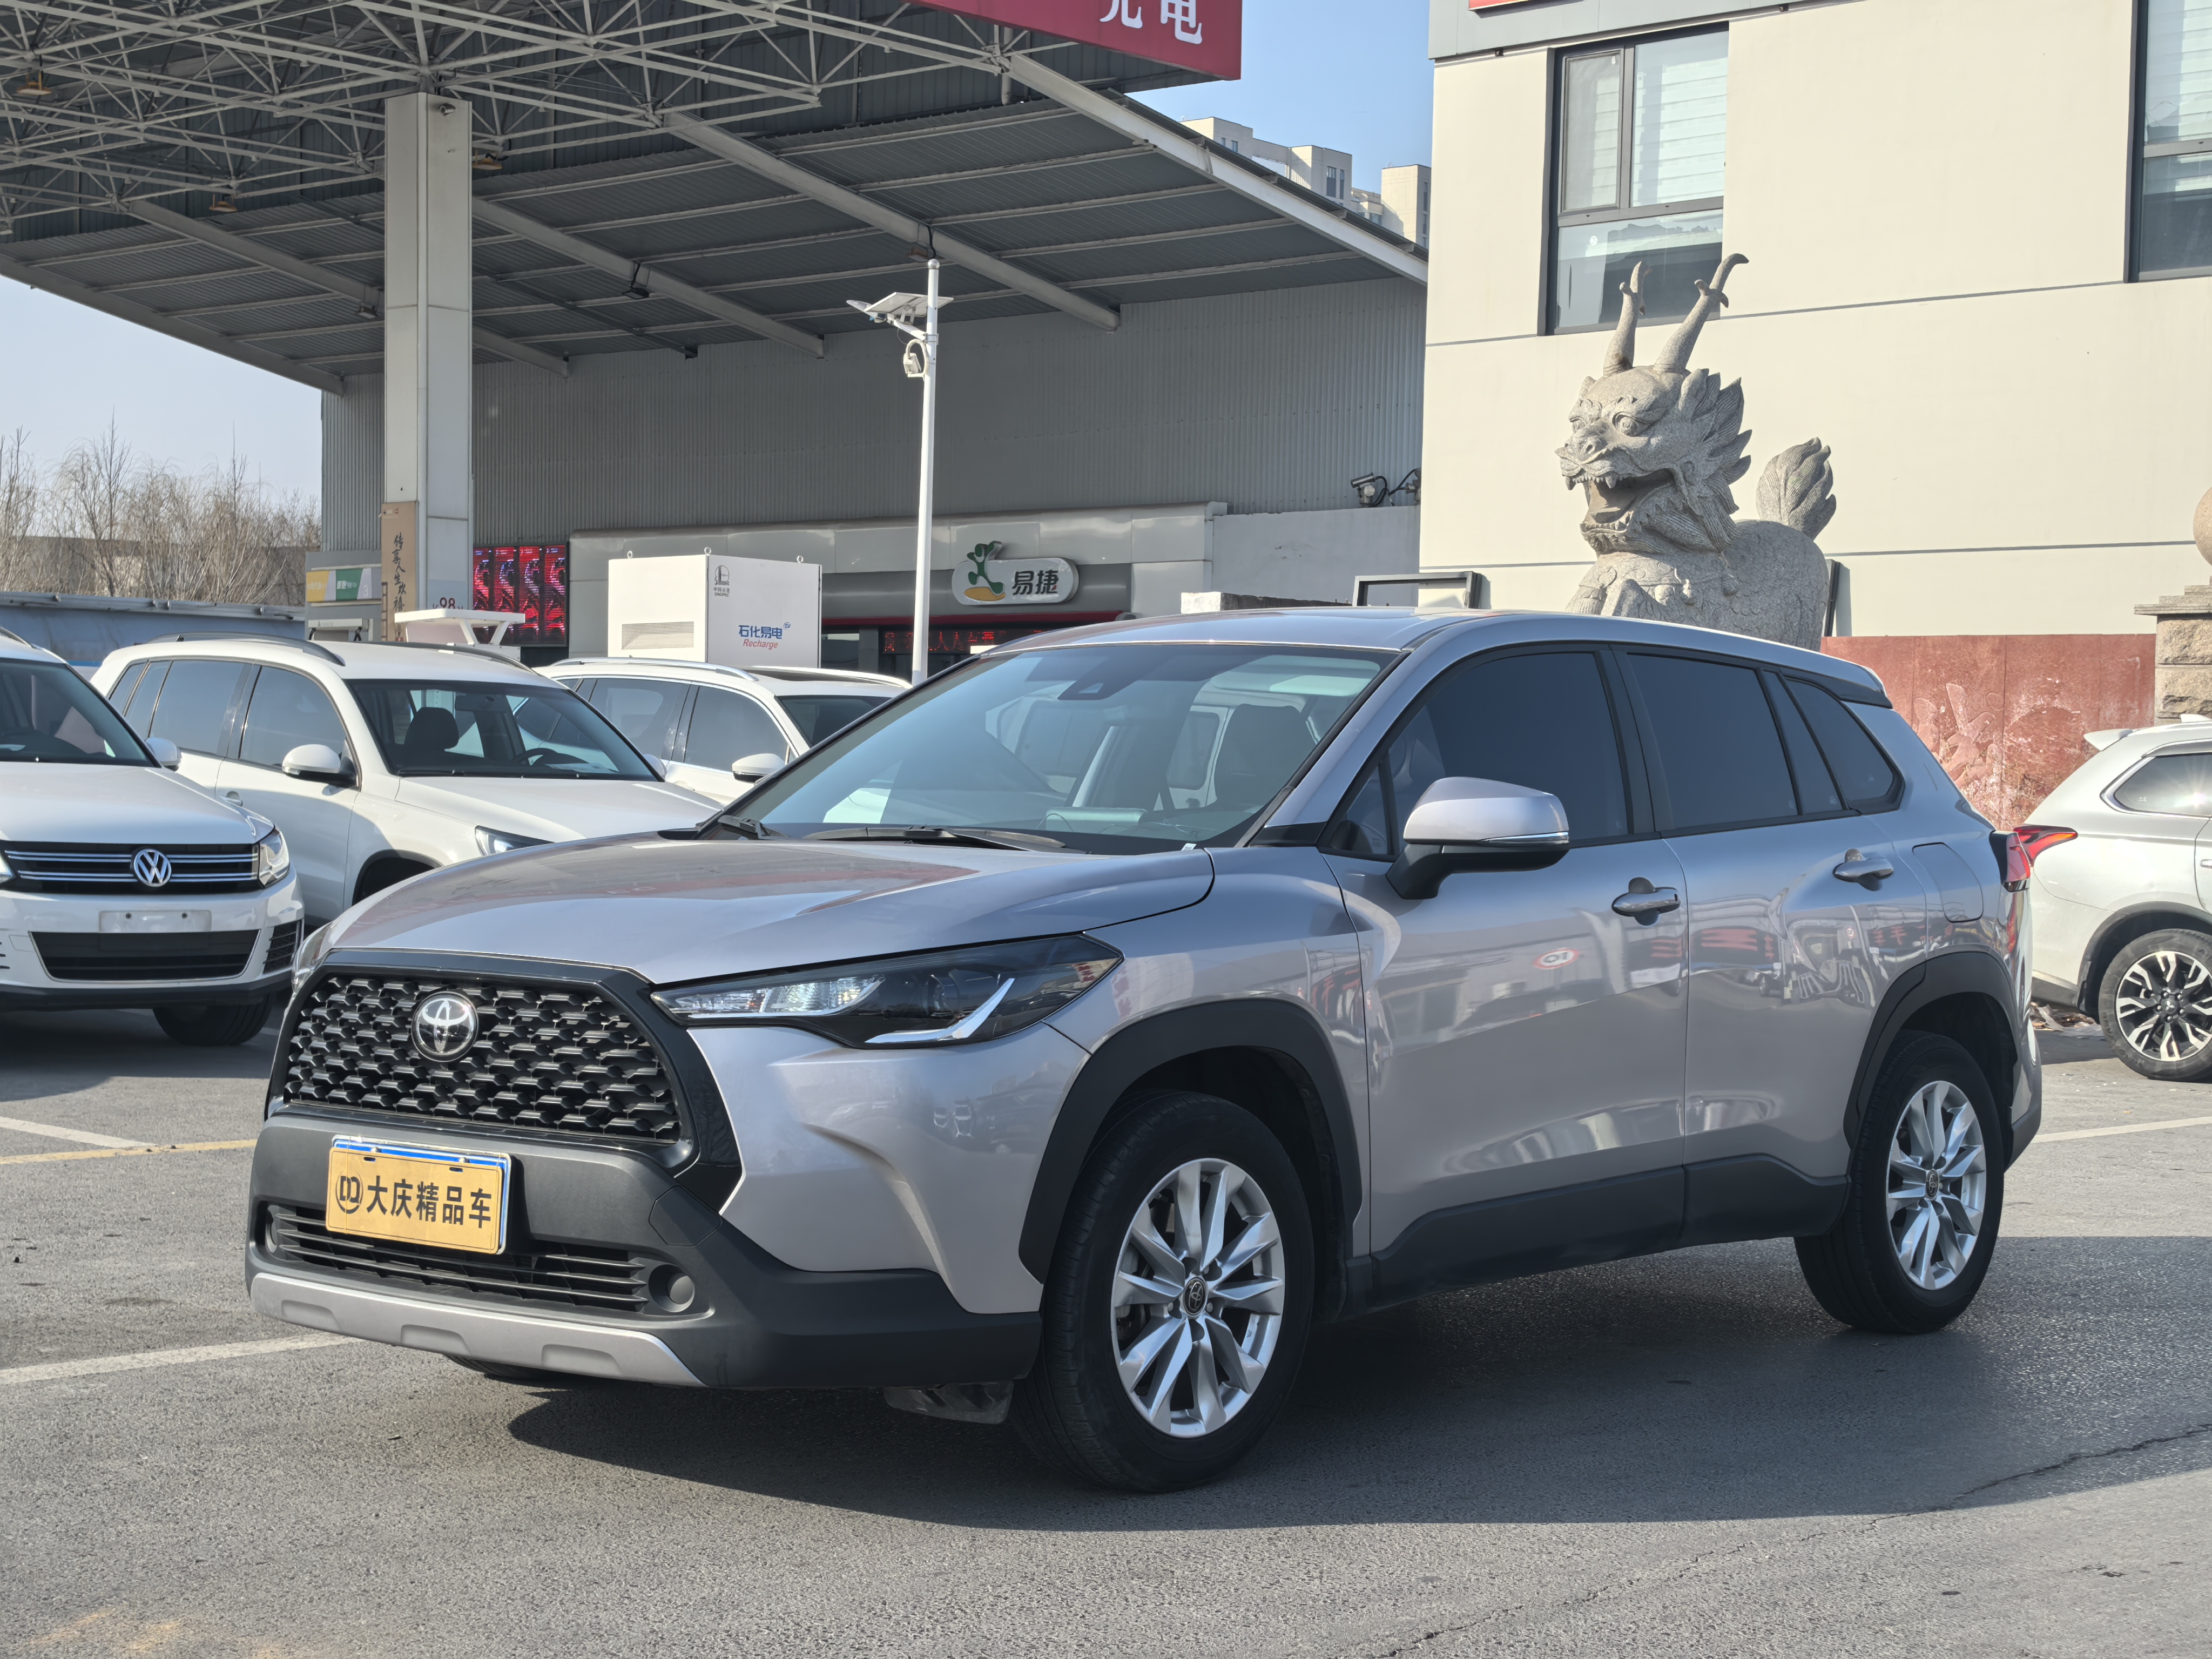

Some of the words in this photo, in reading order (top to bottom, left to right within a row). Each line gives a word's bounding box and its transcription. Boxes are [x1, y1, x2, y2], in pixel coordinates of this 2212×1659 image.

[1012, 570, 1059, 595] 易捷
[739, 625, 783, 639] 石化易电
[743, 639, 778, 650] Recharge
[366, 1175, 492, 1229] 大庆精品车
